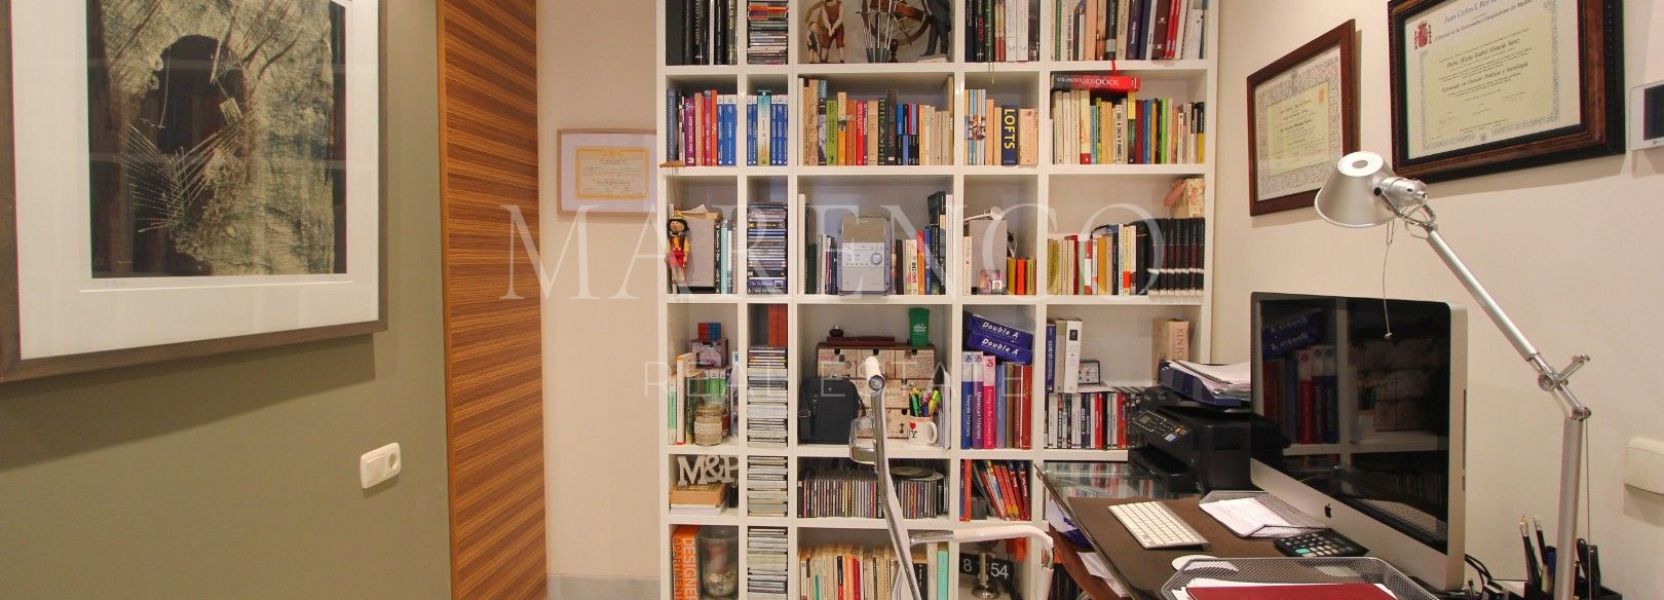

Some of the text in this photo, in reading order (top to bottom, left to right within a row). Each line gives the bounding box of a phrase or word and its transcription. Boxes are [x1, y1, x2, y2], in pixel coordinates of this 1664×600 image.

[1004, 109, 1016, 150] LOFTS
[982, 321, 1019, 339] Double A
[981, 338, 1019, 356] Double A
[963, 558, 1009, 579] 8 54
